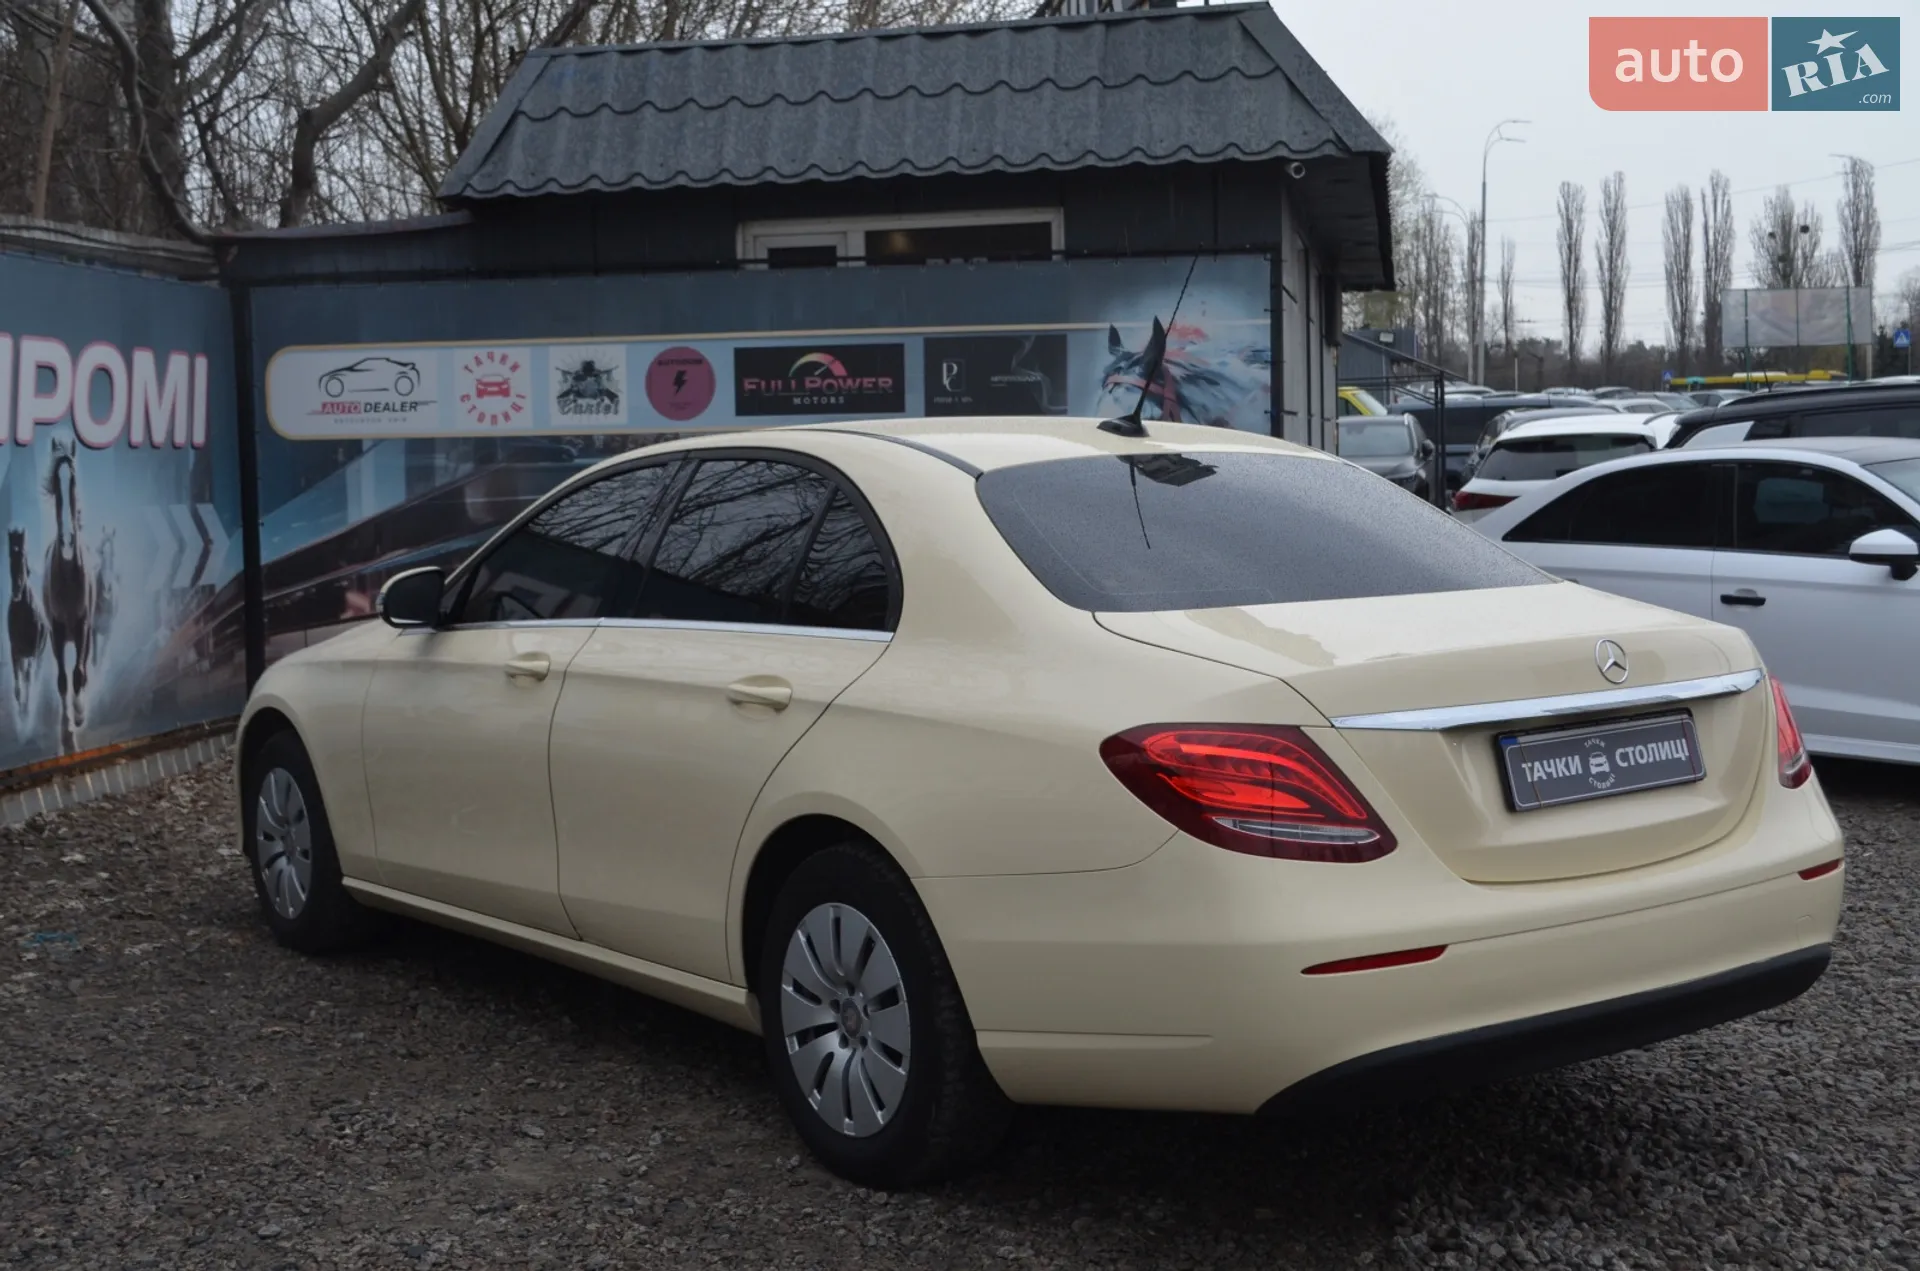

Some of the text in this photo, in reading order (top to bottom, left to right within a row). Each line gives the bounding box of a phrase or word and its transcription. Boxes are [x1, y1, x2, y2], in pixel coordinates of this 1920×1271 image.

[322, 401, 418, 414] AUTO DEALER
[793, 396, 845, 406] MOTORS
[1521, 737, 1690, 784] ТАЧКИ СТОЛИЦІ
